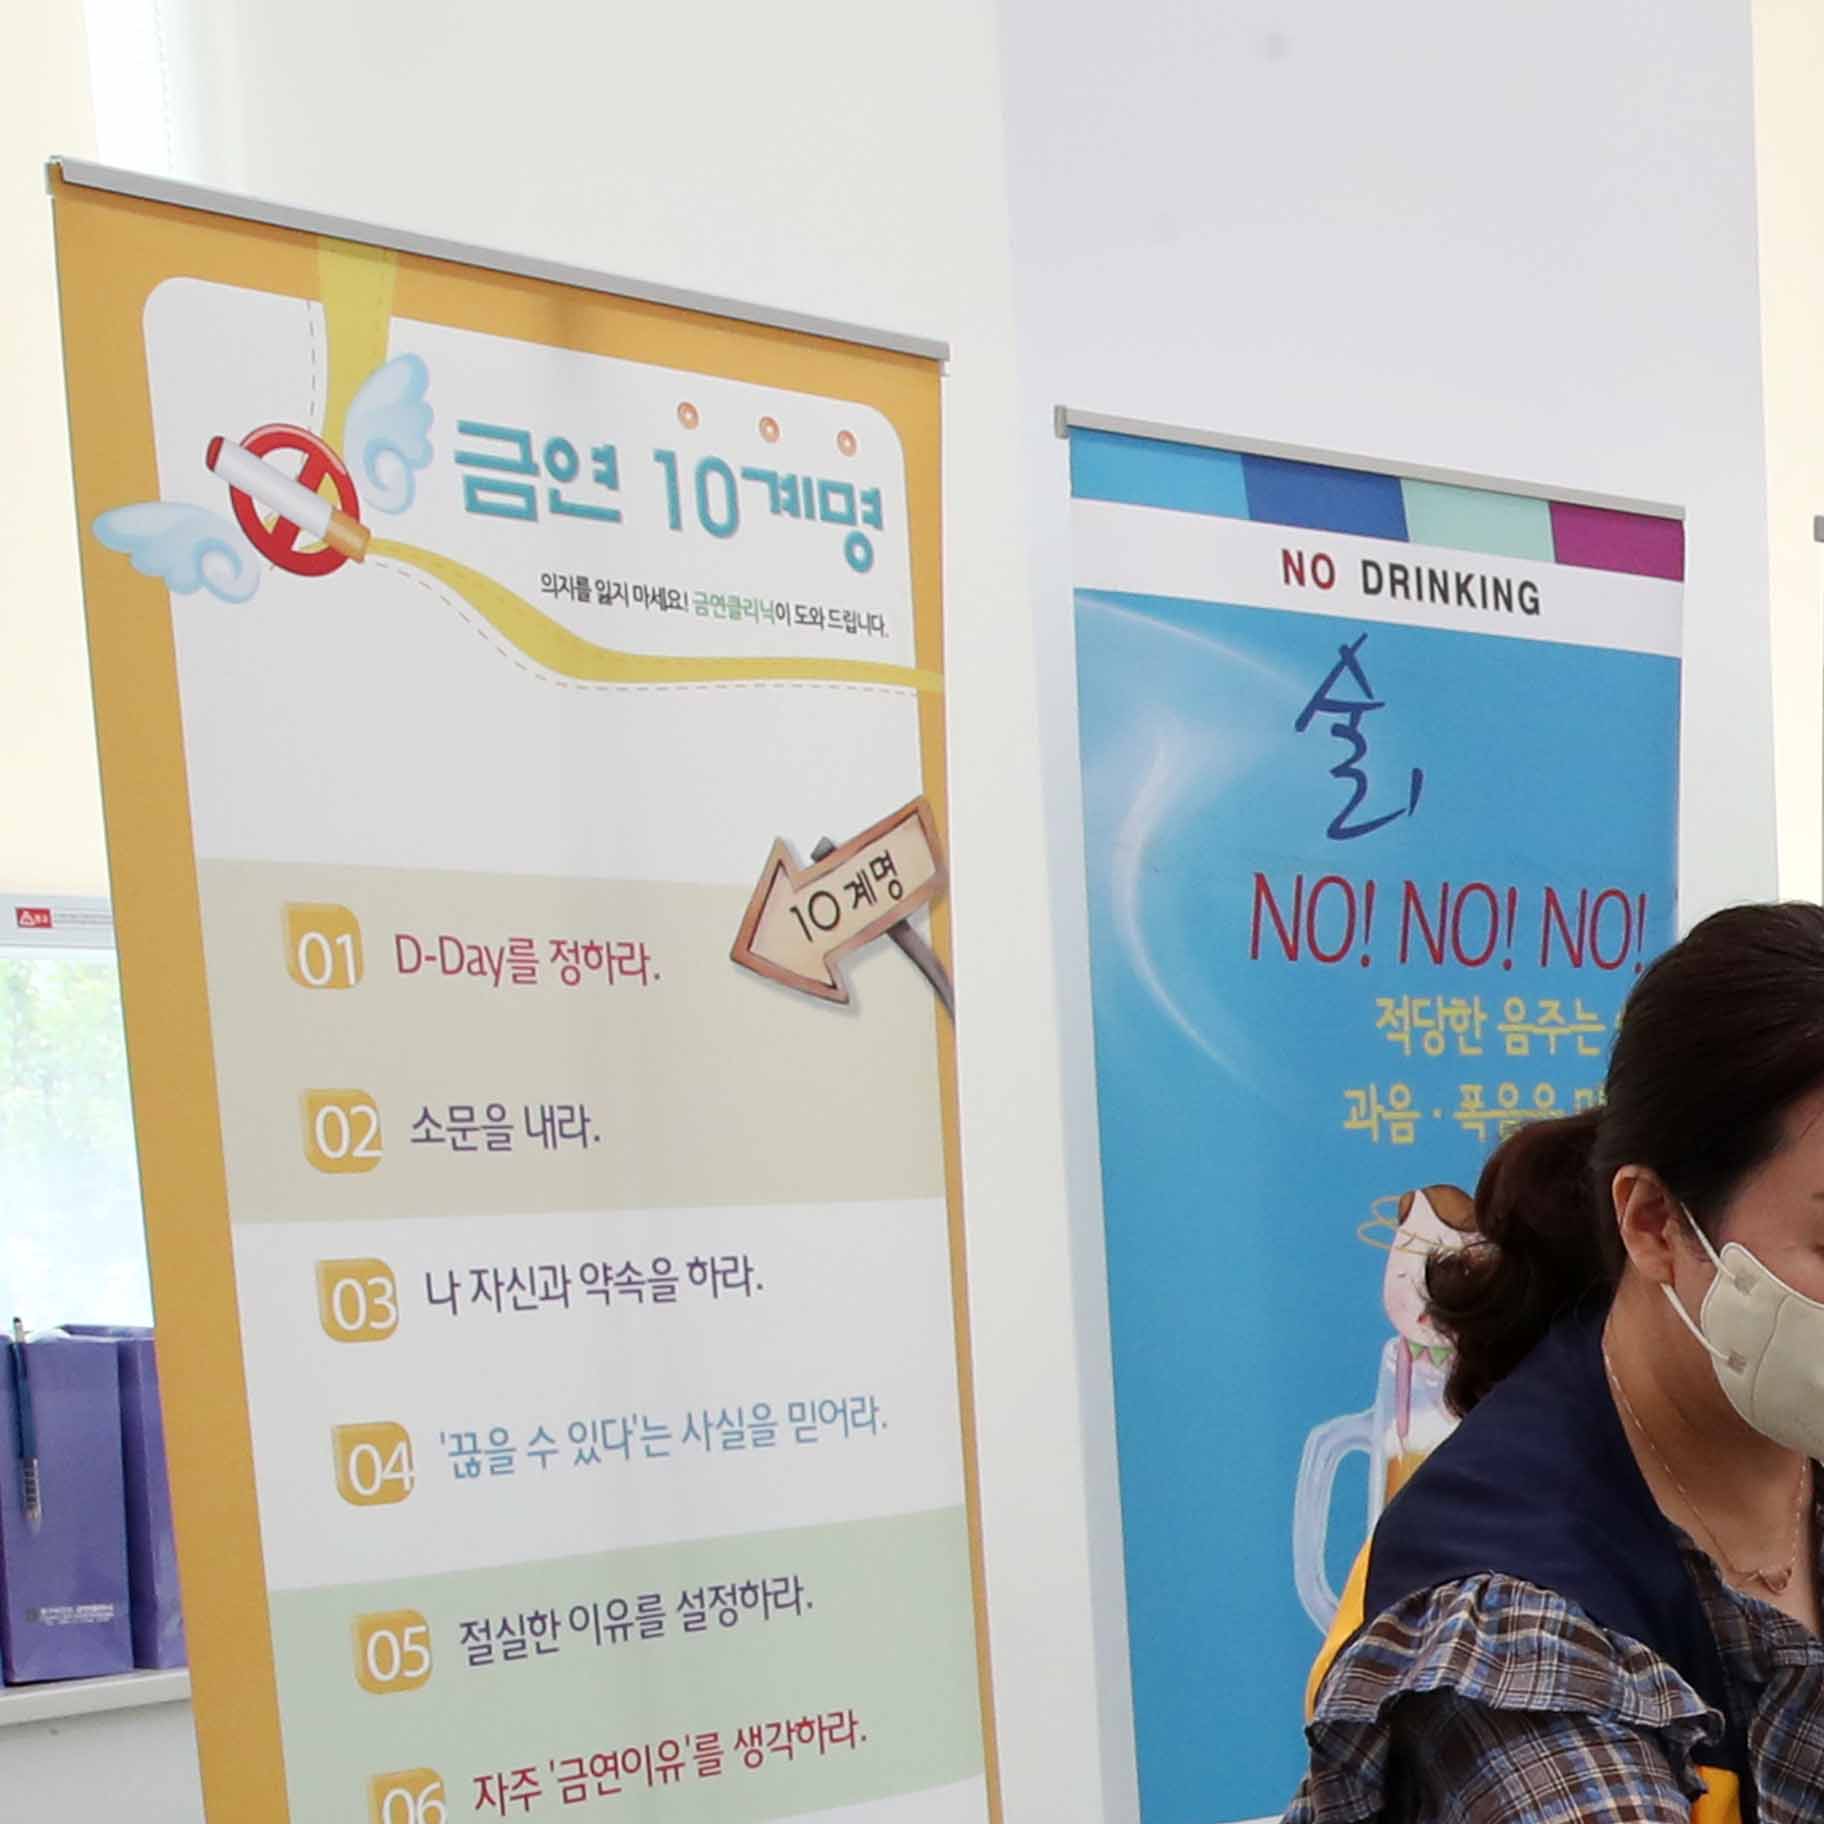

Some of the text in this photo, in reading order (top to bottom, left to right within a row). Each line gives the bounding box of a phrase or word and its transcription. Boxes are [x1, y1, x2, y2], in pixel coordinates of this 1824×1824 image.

[454, 418, 885, 574] 금연 10계명
[633, 584, 689, 612] 마세요!
[693, 590, 791, 628] 금연클리닉이
[795, 603, 825, 631] 도와
[828, 608, 890, 639] 드립니다.
[1282, 548, 1542, 617] NO DRINKING
[788, 850, 904, 944] 10 계명
[1250, 871, 1646, 973] NO! NO! NO!
[298, 930, 661, 989] 01 D-Day를 정하라.
[1374, 994, 1606, 1056] 적당한 음주는
[314, 1102, 600, 1160] 02 소문을 내라.
[1343, 1082, 1421, 1145] 과음
[332, 1254, 764, 1332] 03 나 자신과 약속을 하라.
[348, 1395, 887, 1496] 04 '끊을 수 있다'는 사실을 믿어라.
[366, 1575, 814, 1682] 05 절실한 이유를 설정하라.
[472, 1765, 543, 1817] 자주
[548, 1729, 723, 1804] '금연이유'를
[734, 1708, 868, 1770] 생각하라.
